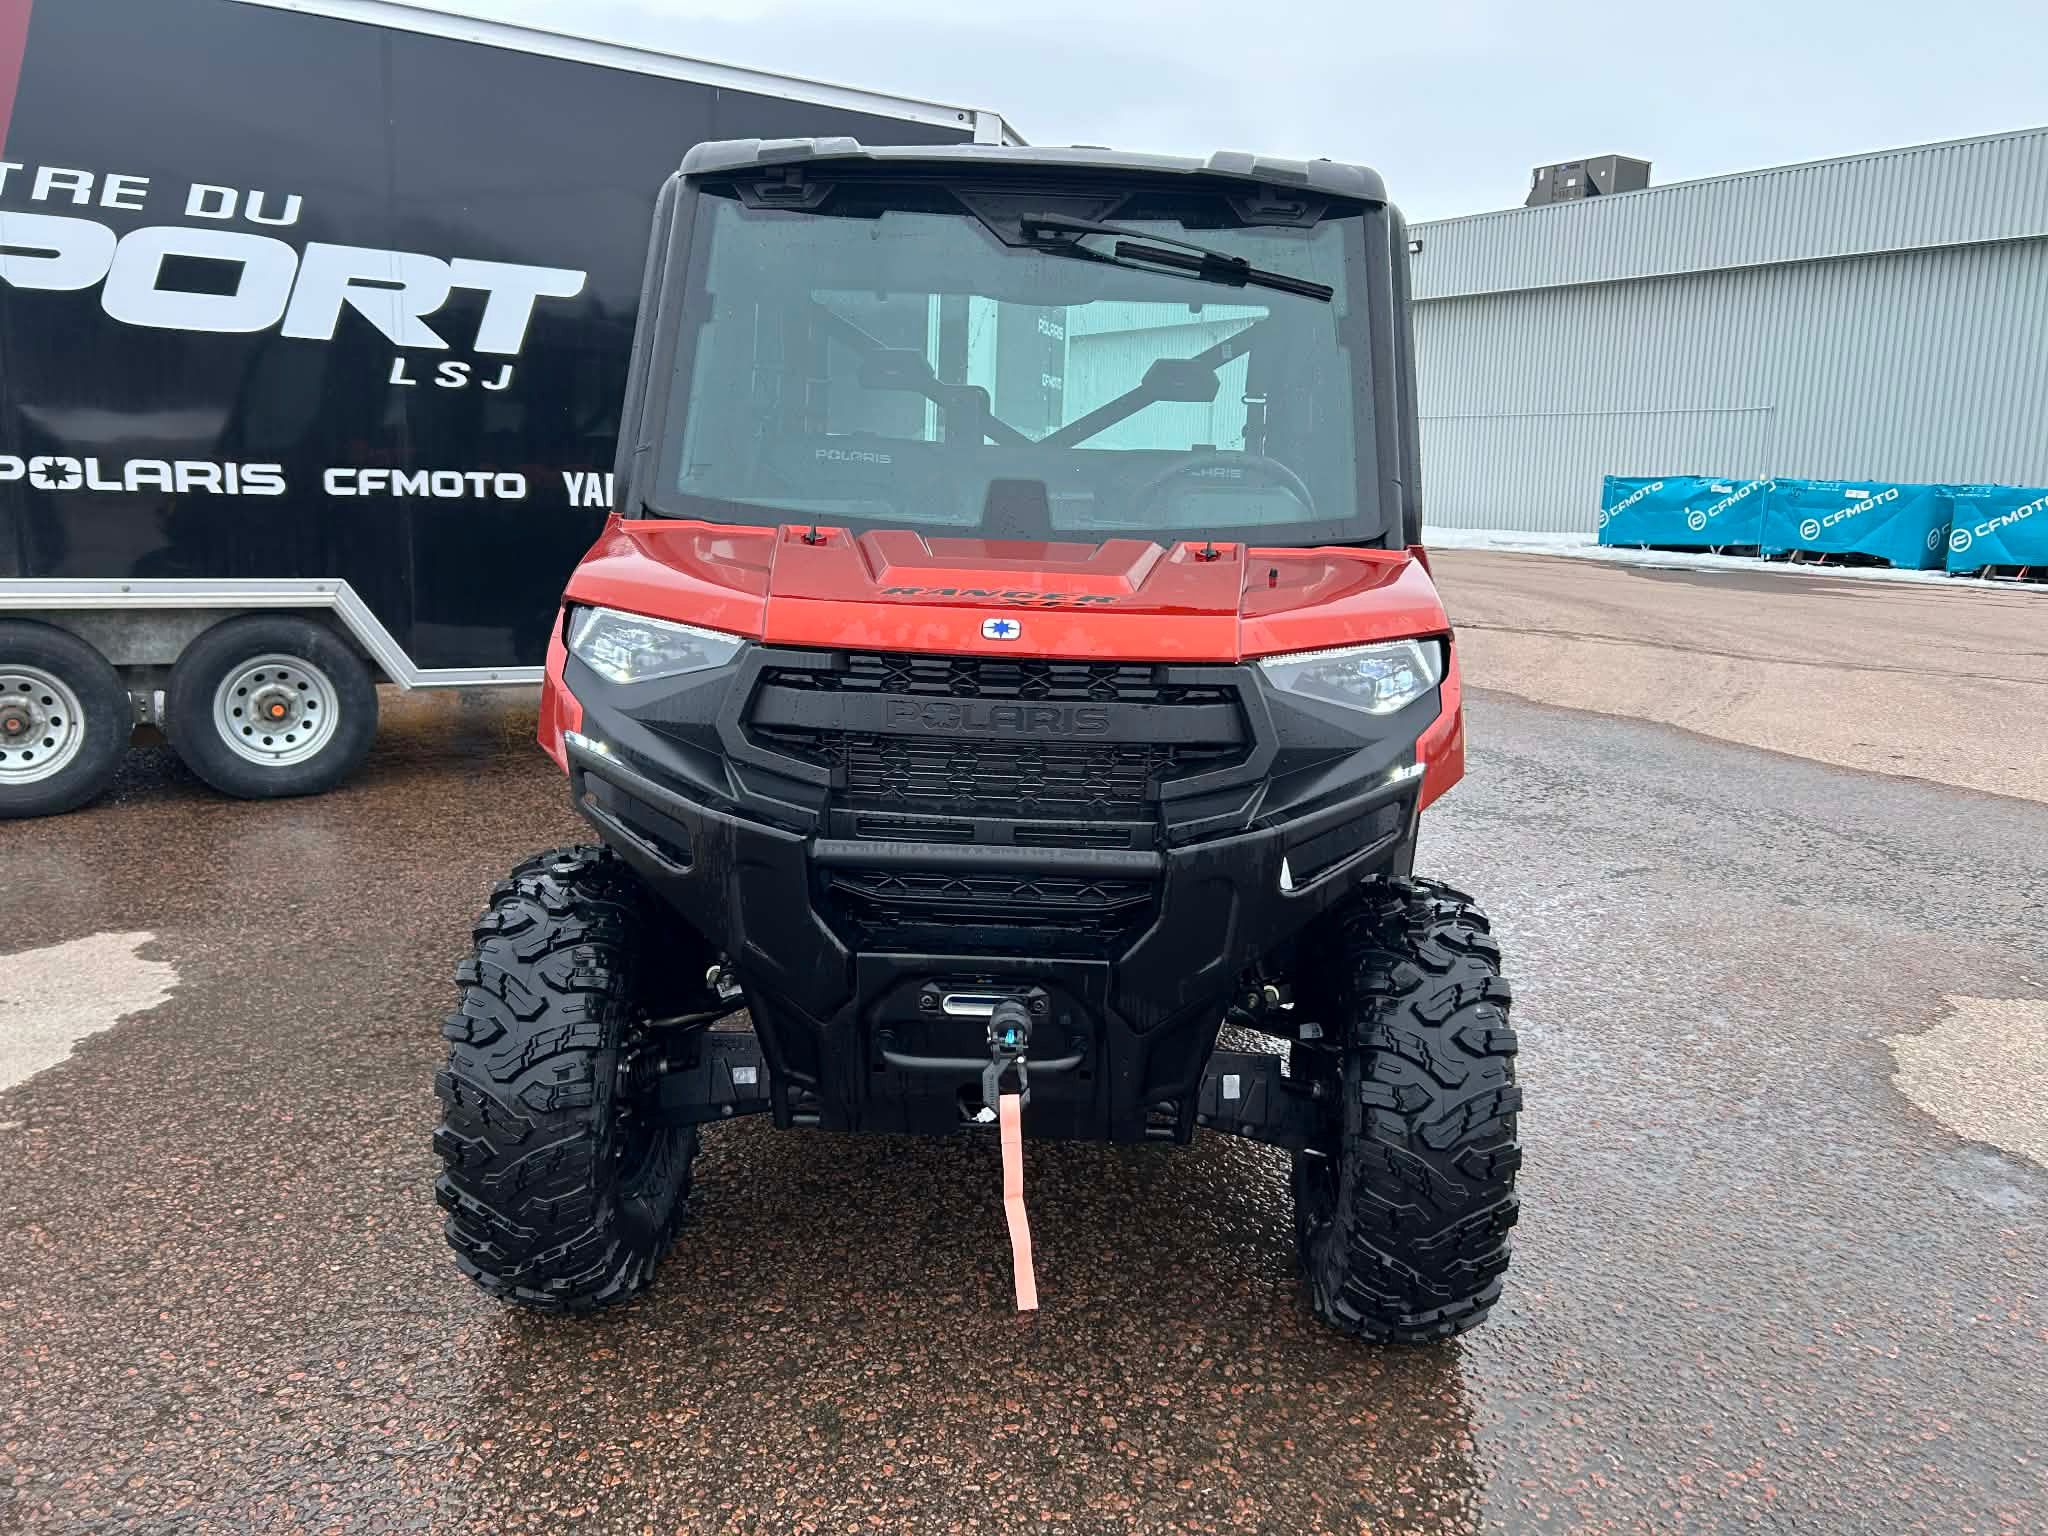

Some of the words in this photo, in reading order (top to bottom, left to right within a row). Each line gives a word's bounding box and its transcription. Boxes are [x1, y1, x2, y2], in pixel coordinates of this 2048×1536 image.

[184, 183, 303, 226] DU
[389, 357, 513, 391] LSJ
[815, 449, 893, 464] POLARIS
[324, 468, 526, 499] CFMOTO
[1610, 480, 1664, 517] CFMOTO
[1822, 487, 1899, 528] CFMOTO
[880, 587, 1118, 603] RANGER
[884, 700, 1112, 736] POLARIS
